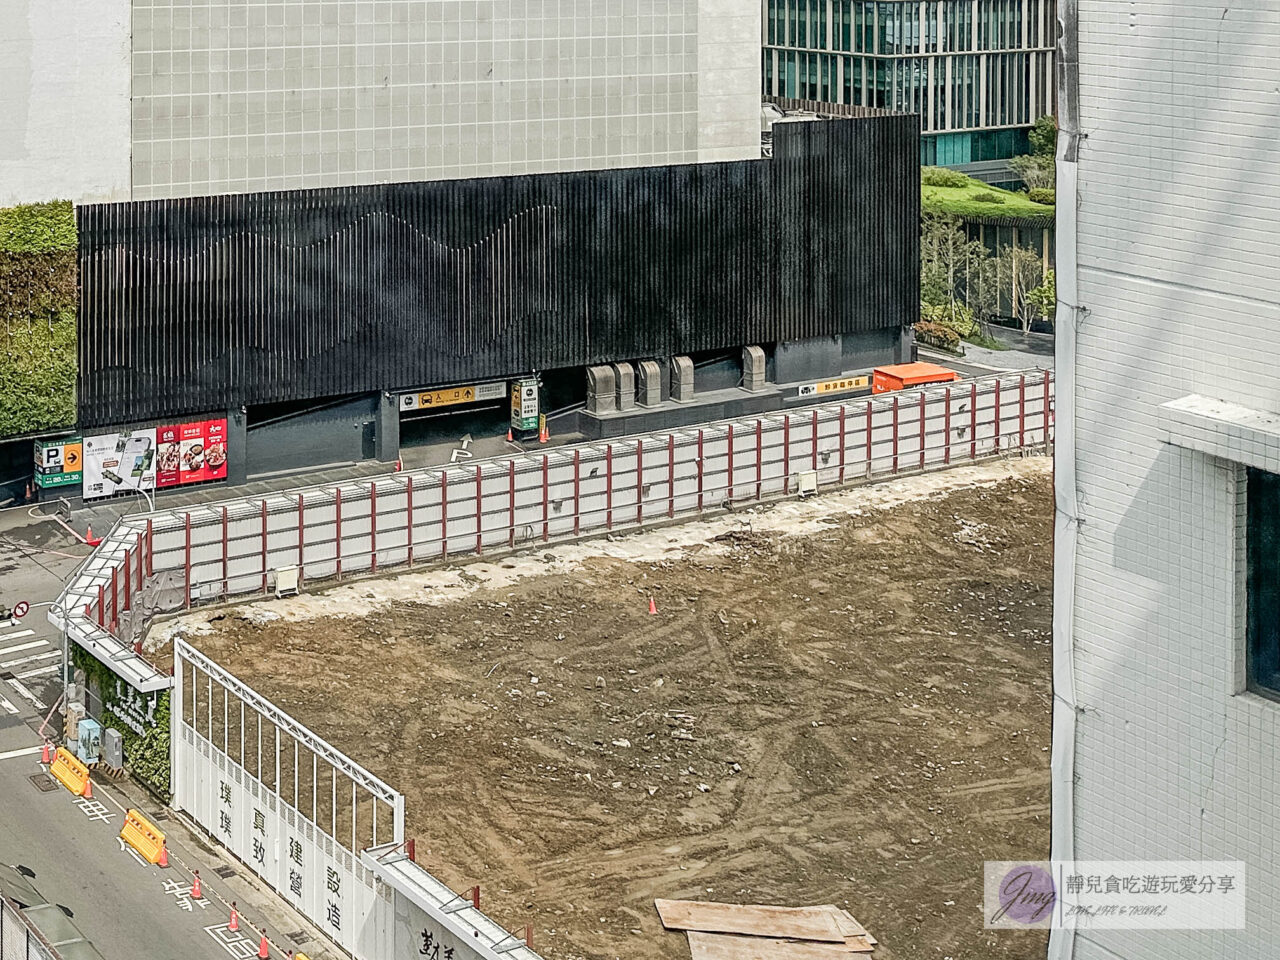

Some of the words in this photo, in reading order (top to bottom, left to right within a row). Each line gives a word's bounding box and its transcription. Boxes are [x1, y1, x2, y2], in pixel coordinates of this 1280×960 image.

[46, 448, 59, 464] P
[220, 780, 341, 898] 璞真建設
